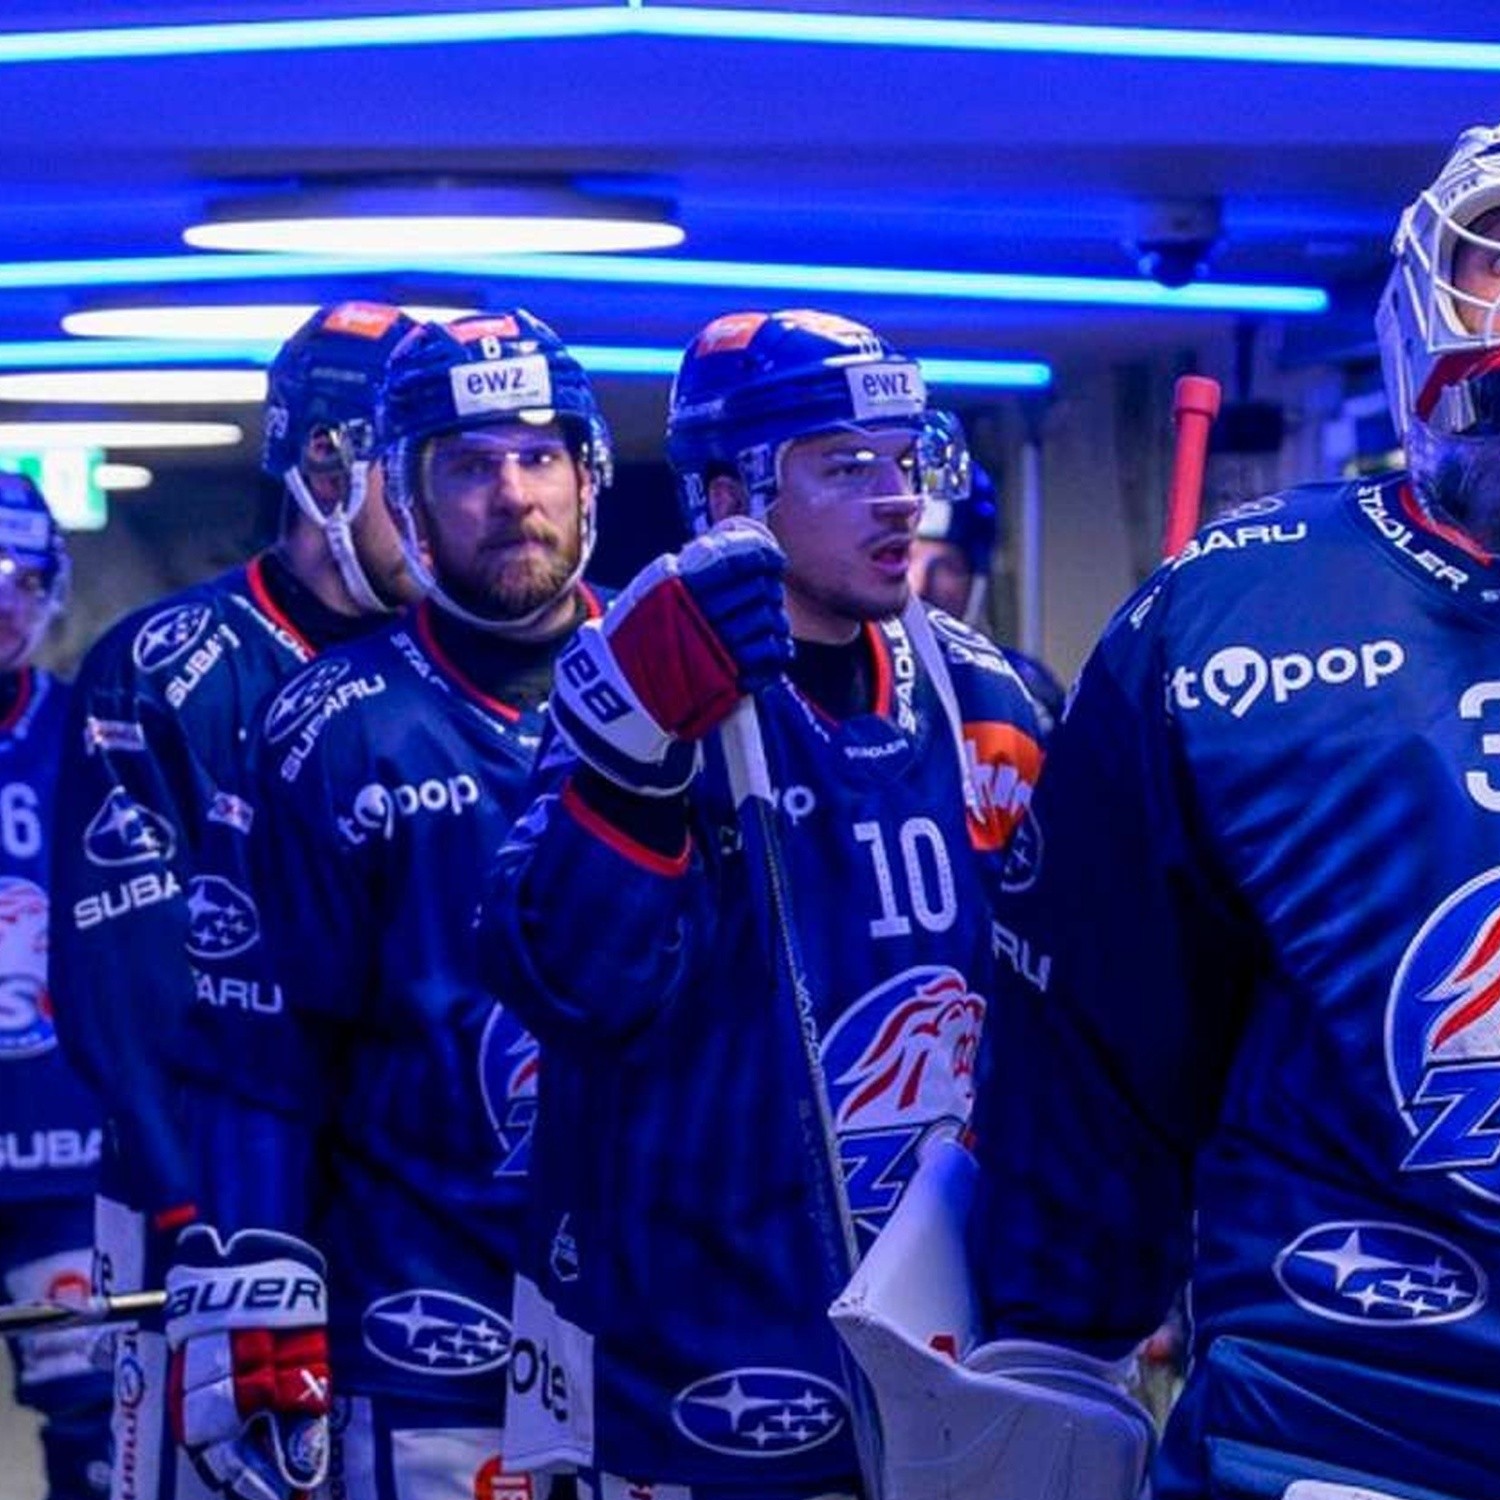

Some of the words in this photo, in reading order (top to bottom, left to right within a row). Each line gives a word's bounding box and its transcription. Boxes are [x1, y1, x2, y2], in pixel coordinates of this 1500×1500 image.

[466, 366, 526, 395] ewz
[862, 373, 913, 397] ewz
[852, 816, 957, 940] 10
